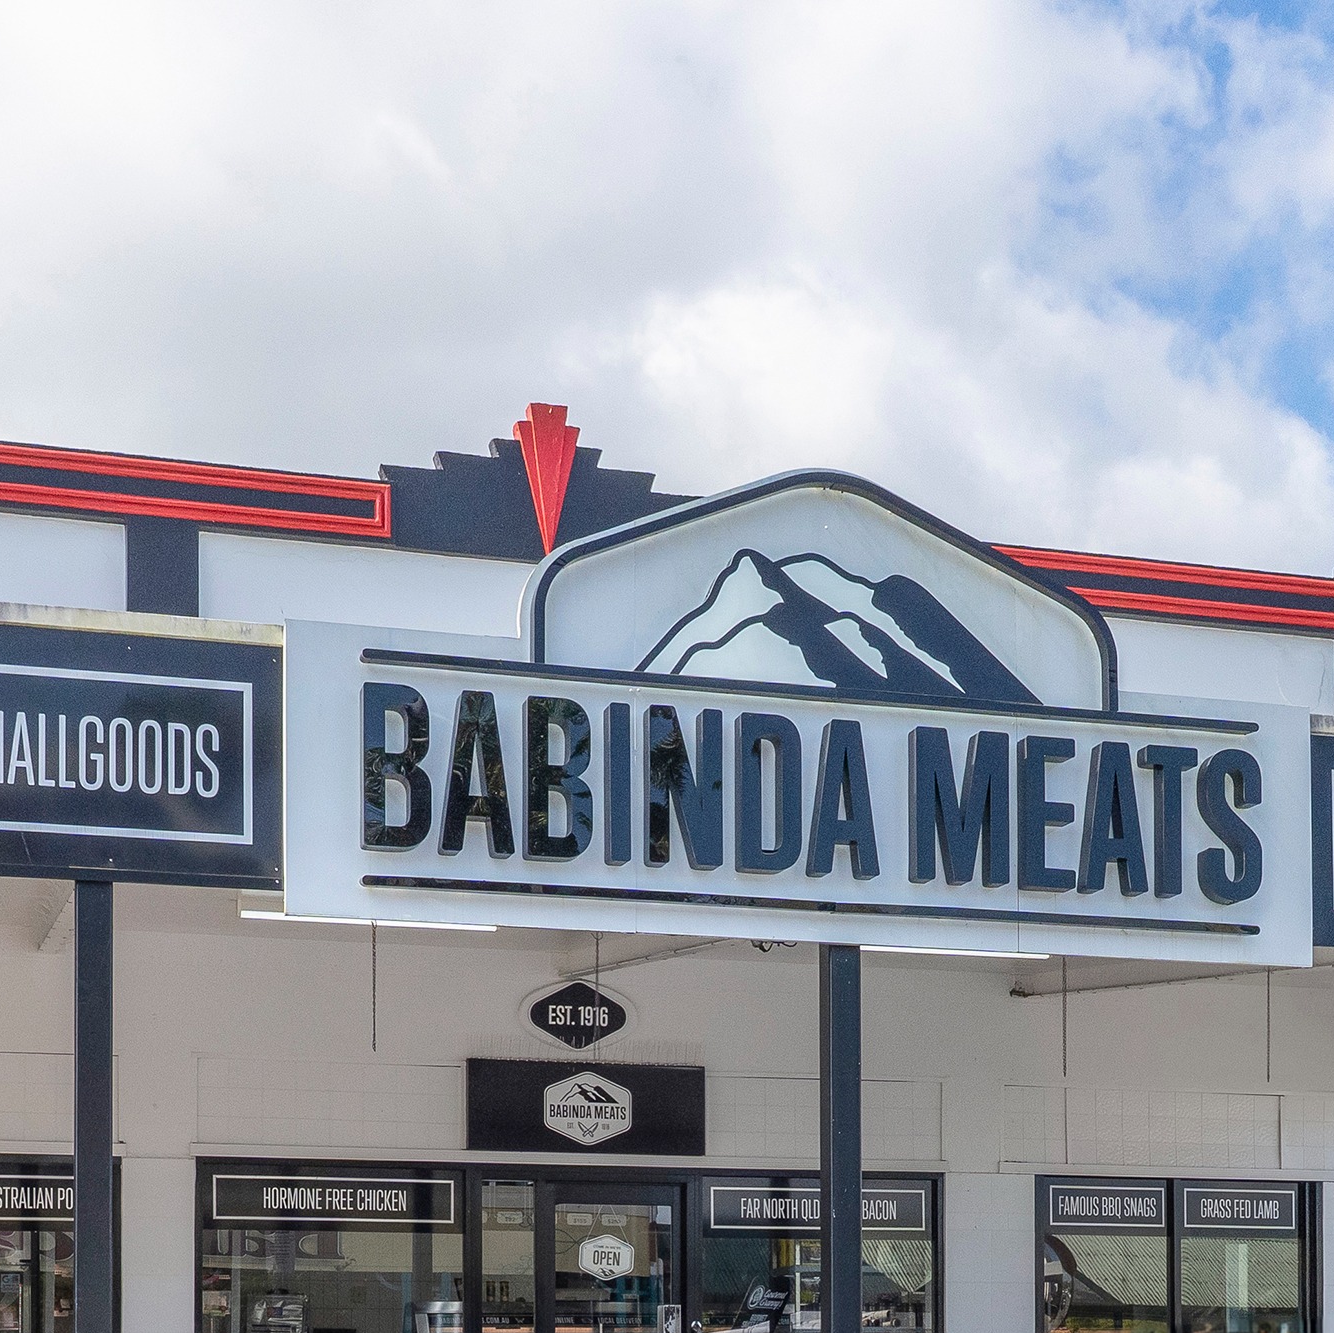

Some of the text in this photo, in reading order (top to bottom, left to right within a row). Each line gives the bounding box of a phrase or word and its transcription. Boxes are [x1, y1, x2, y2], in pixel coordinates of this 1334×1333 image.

[359, 680, 1263, 906] BABINDA MEATS
[548, 1004, 609, 1027] EST. 1916
[549, 1104, 627, 1120] BABINDA MEATS
[57, 1187, 74, 1210] PO
[263, 1187, 407, 1212] HORMONE FREE CHICKEN
[740, 1198, 897, 1222] FAR NORTH QLD BACON
[1058, 1195, 1157, 1218] FAMOUS BBQ SNAGS
[1200, 1198, 1279, 1220] GRASS FED LAMB
[593, 1250, 621, 1266] OPEN
